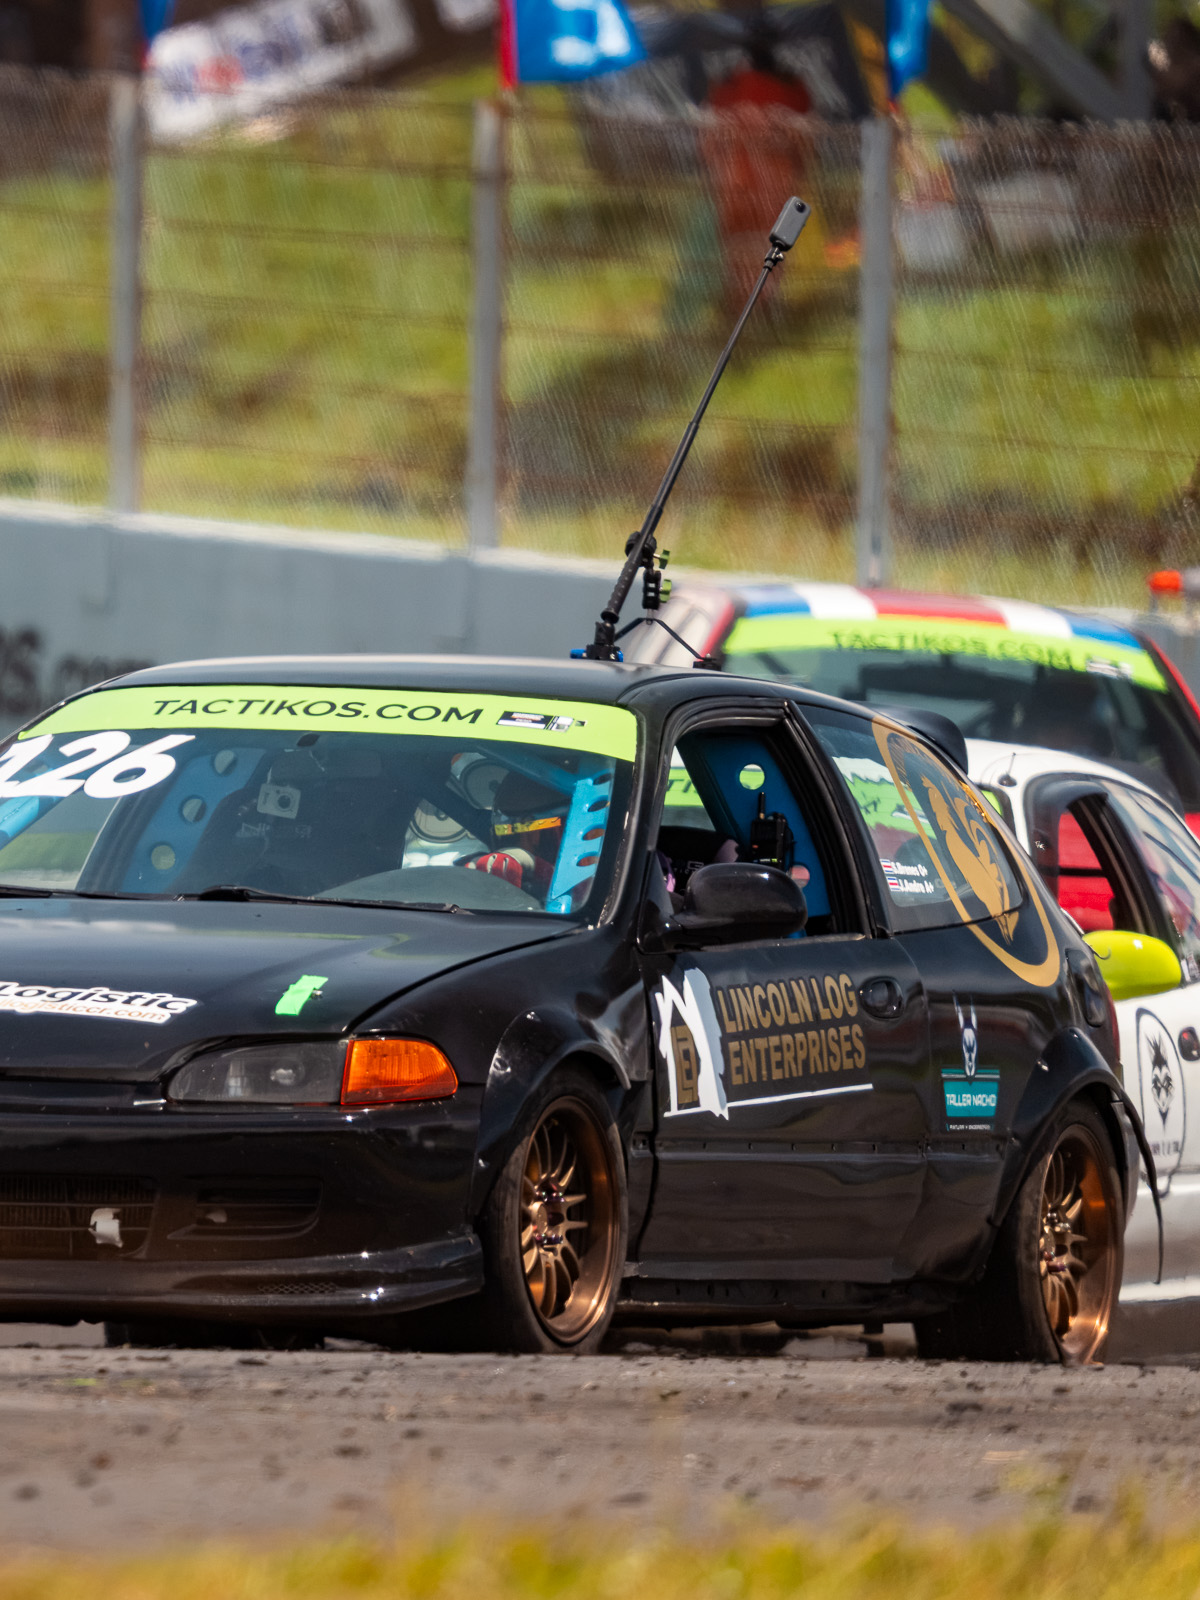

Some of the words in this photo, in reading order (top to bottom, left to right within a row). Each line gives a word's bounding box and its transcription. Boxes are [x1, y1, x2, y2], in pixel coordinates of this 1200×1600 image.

[827, 630, 1074, 669] TACTIKOS.COM
[153, 698, 484, 725] TACTIKOS.COM
[717, 977, 814, 1034] LINCOLN
[811, 973, 859, 1021] LOG
[728, 1023, 867, 1086] ENTERPRISES
[945, 1093, 972, 1107] TALLER
[972, 1093, 997, 1107] NACHO
